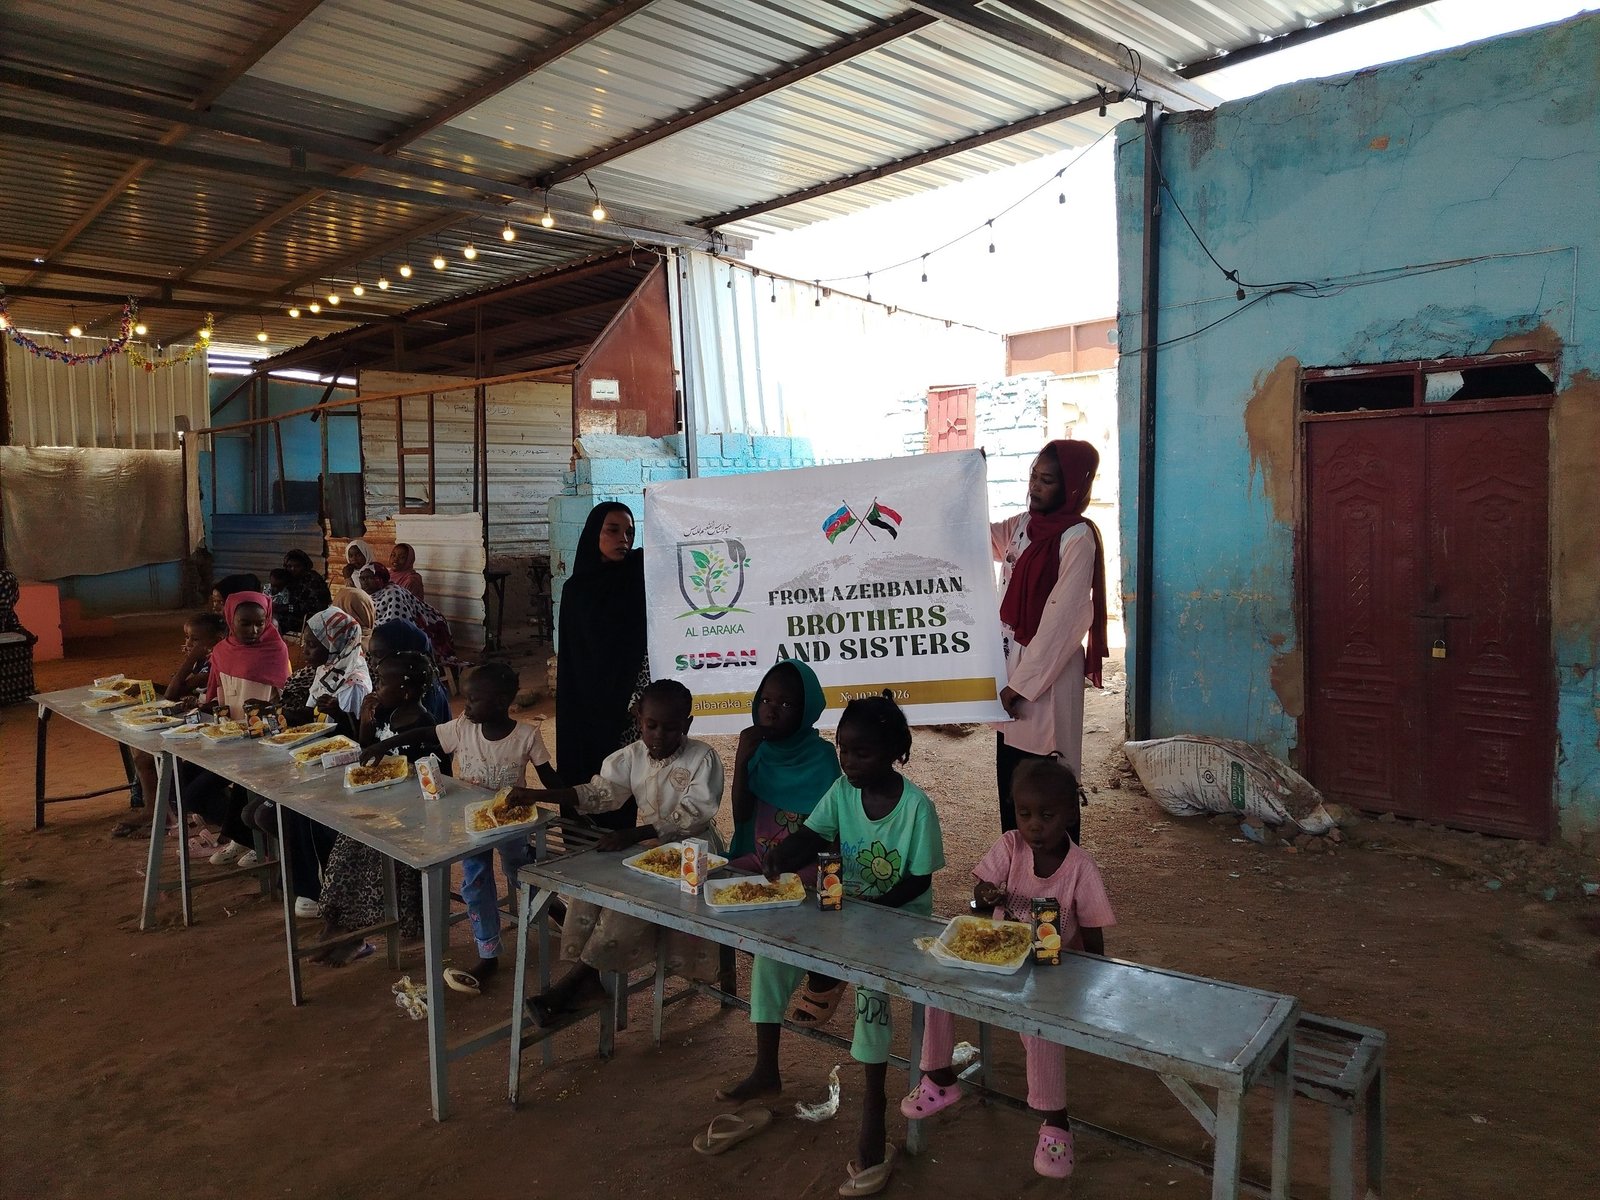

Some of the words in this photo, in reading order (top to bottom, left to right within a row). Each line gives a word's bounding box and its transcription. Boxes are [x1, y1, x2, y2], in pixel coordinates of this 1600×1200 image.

[768, 587, 825, 606] FROM
[832, 576, 963, 602] AZERBAIJAN
[685, 627, 699, 637] AL
[702, 623, 745, 636] BARAKA
[787, 604, 947, 637] BROTHERS
[675, 649, 757, 671] SUDAN
[775, 640, 831, 665] AND
[839, 631, 971, 660] SISTERS
